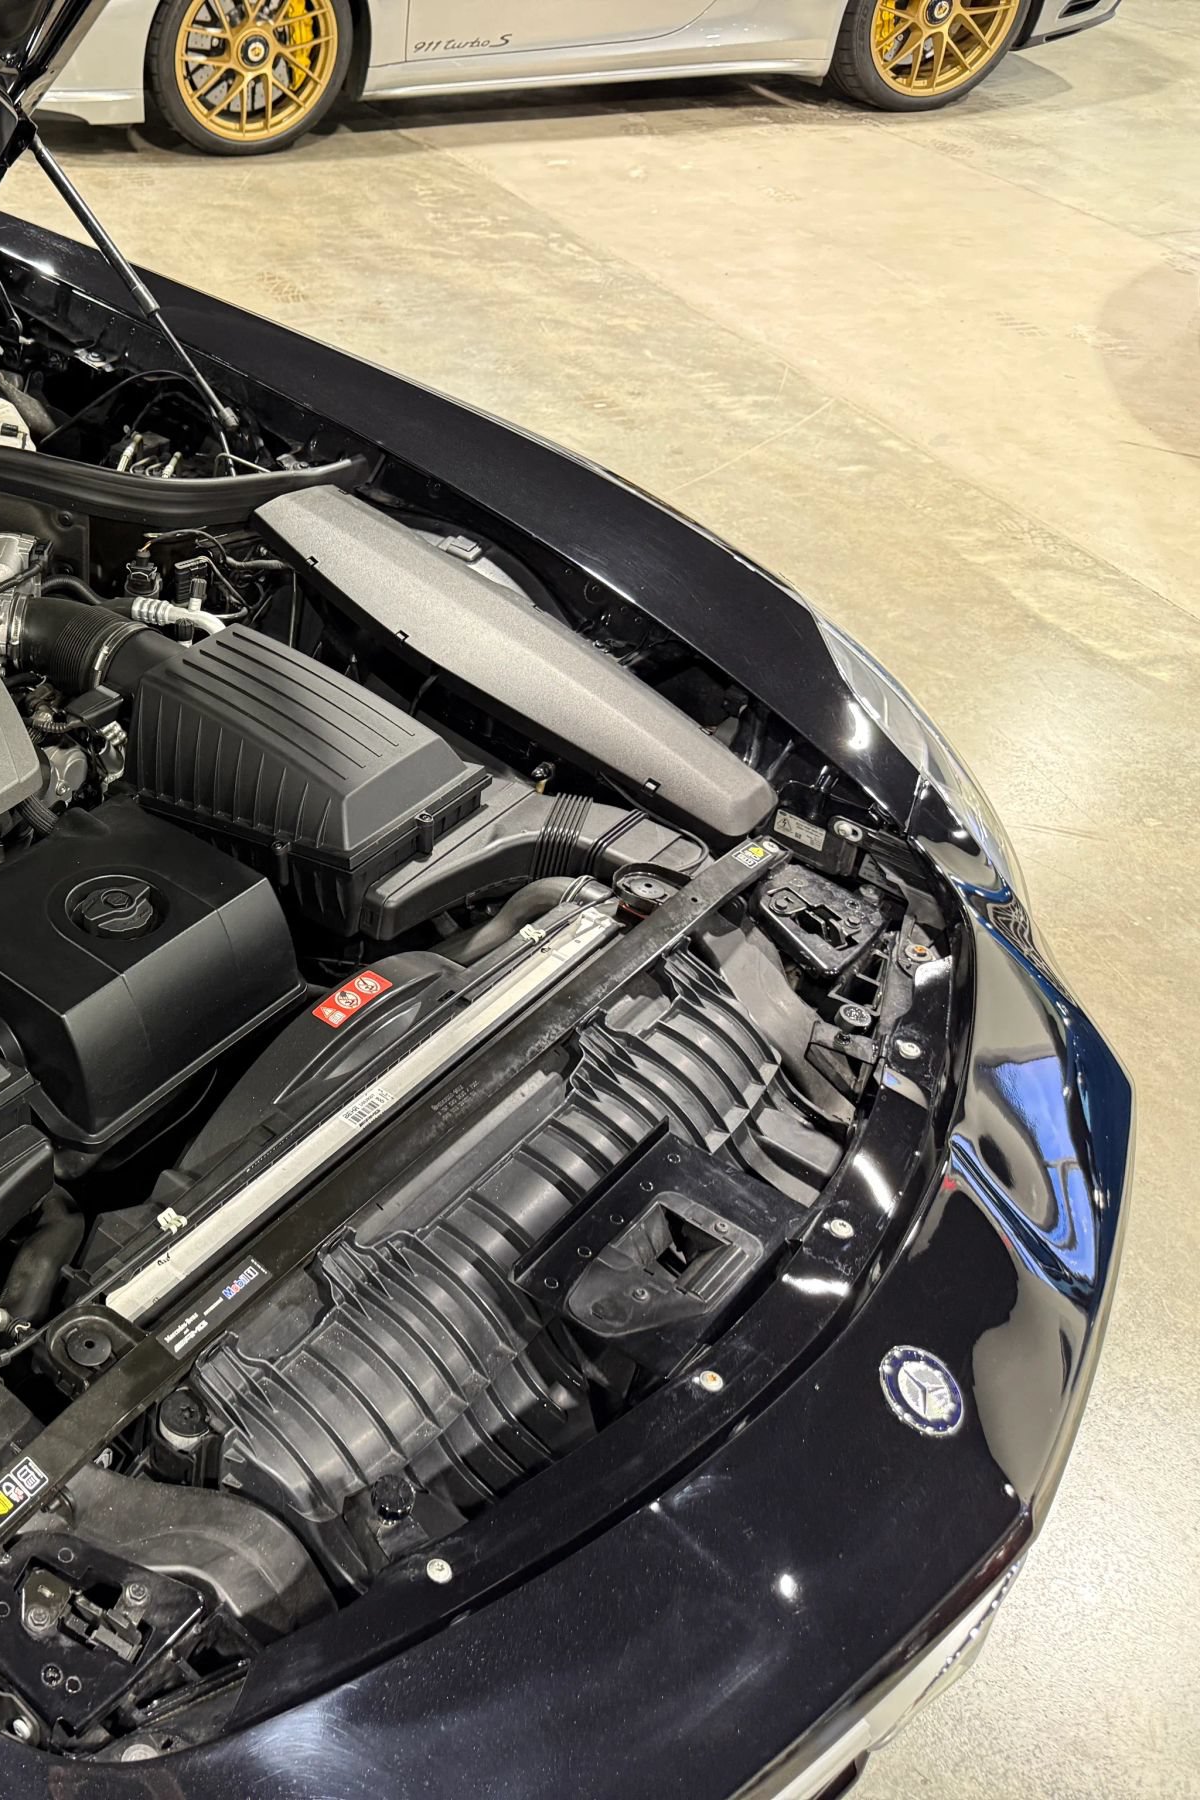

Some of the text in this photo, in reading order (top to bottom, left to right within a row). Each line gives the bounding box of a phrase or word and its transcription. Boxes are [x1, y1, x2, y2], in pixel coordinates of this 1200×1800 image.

[413, 40, 442, 53] 911
[489, 33, 512, 48] S
[222, 1274, 251, 1299] Mobil
